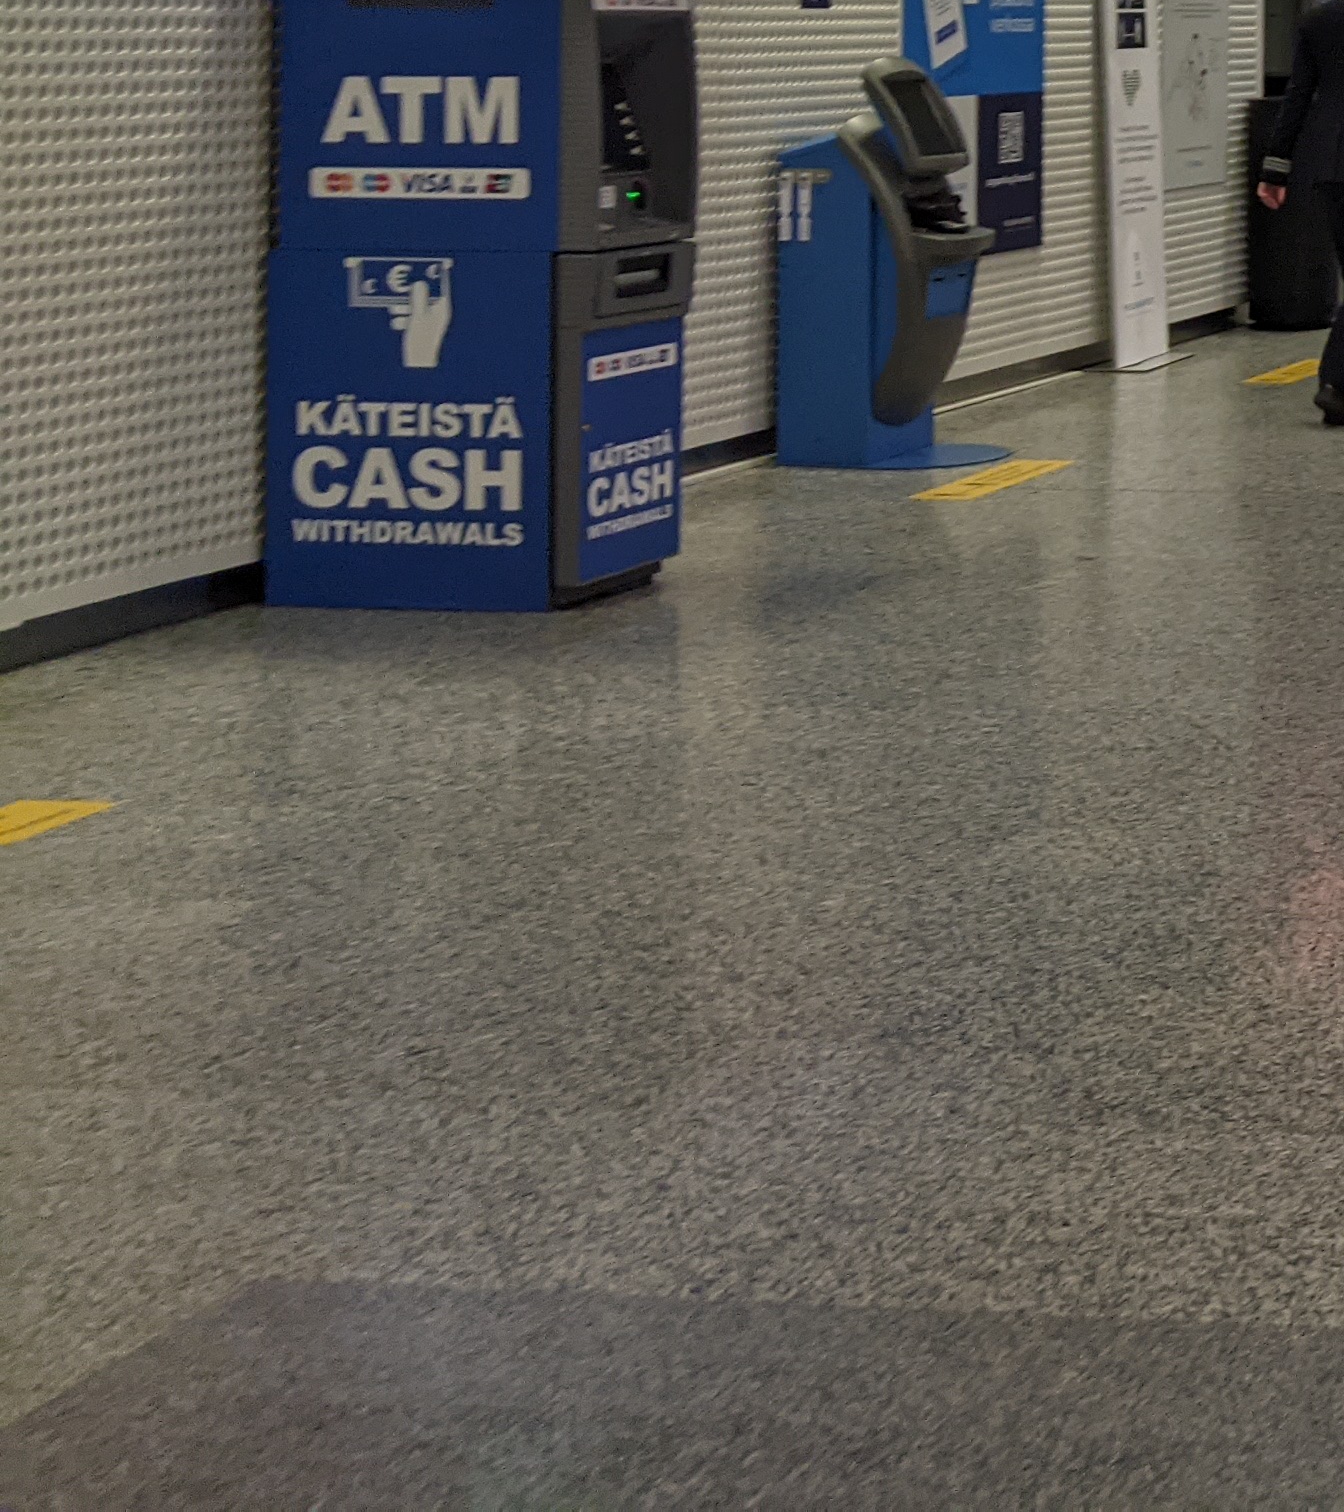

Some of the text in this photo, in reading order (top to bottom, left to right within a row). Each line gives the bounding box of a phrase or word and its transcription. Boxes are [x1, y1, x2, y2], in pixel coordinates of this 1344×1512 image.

[320, 75, 521, 145] ATM
[402, 173, 454, 194] VISA
[294, 395, 523, 439] KÄTEISTÄ
[589, 428, 674, 474] KÄTEISTÄ
[292, 445, 523, 512] CASH
[587, 459, 674, 518] CASH
[291, 519, 524, 546] WITHDRAWALS
